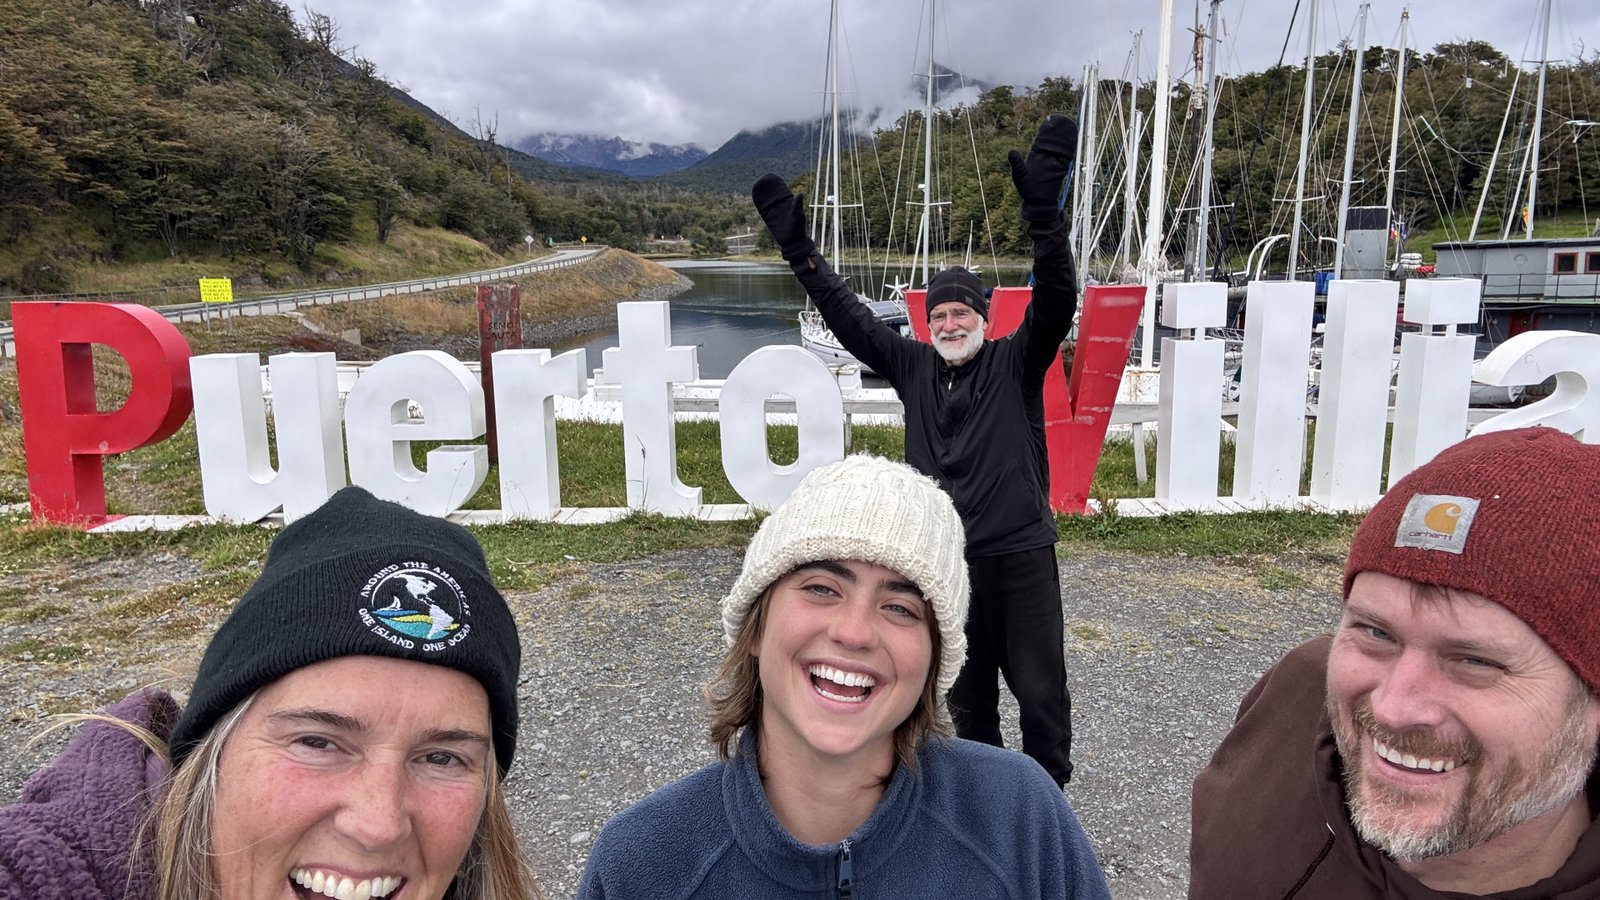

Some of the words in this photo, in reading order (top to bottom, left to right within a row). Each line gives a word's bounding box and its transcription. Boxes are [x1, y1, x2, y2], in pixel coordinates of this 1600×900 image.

[488, 321, 514, 330] SENO
[11, 301, 847, 526] Puerto
[1408, 530, 1453, 541] carhartt
[360, 563, 399, 598] AROUND
[402, 561, 429, 570] THE
[432, 566, 471, 617] AMERICAS
[358, 607, 375, 627] ONE
[370, 625, 415, 649] ISLAND
[422, 641, 447, 652] ONE
[448, 623, 471, 647] OCEAN
